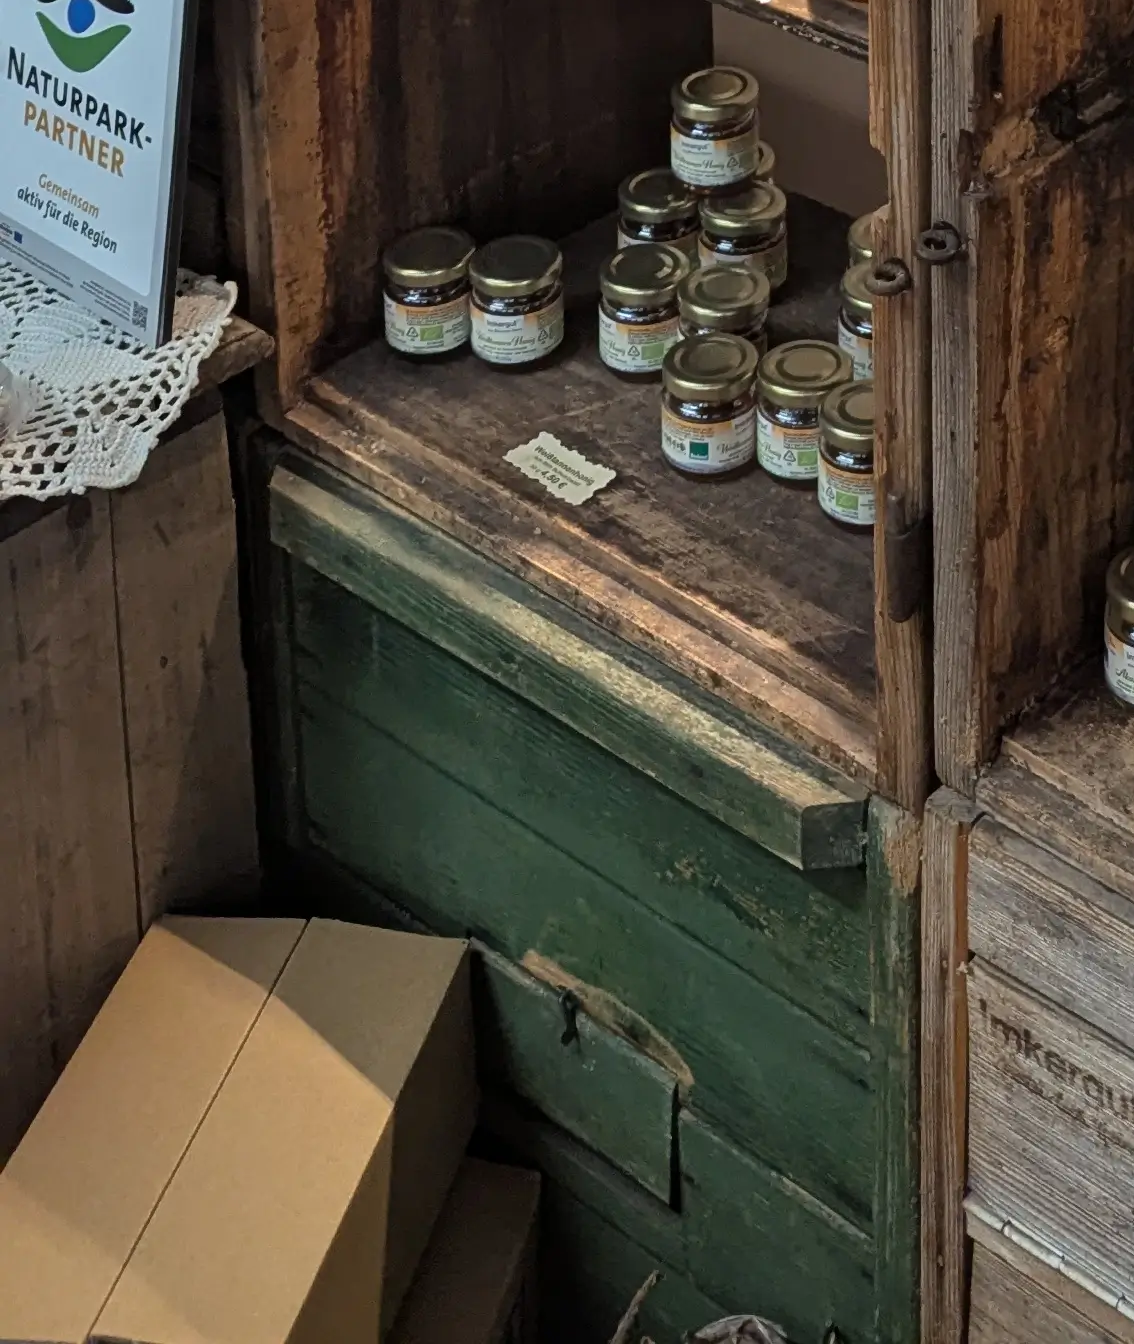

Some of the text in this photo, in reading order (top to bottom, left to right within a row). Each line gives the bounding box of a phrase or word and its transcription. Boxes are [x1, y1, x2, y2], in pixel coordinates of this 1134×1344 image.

[24, 100, 125, 178] PARTNER
[17, 187, 118, 254] aktiv für die Region
[38, 174, 99, 220] Gemeinsam
